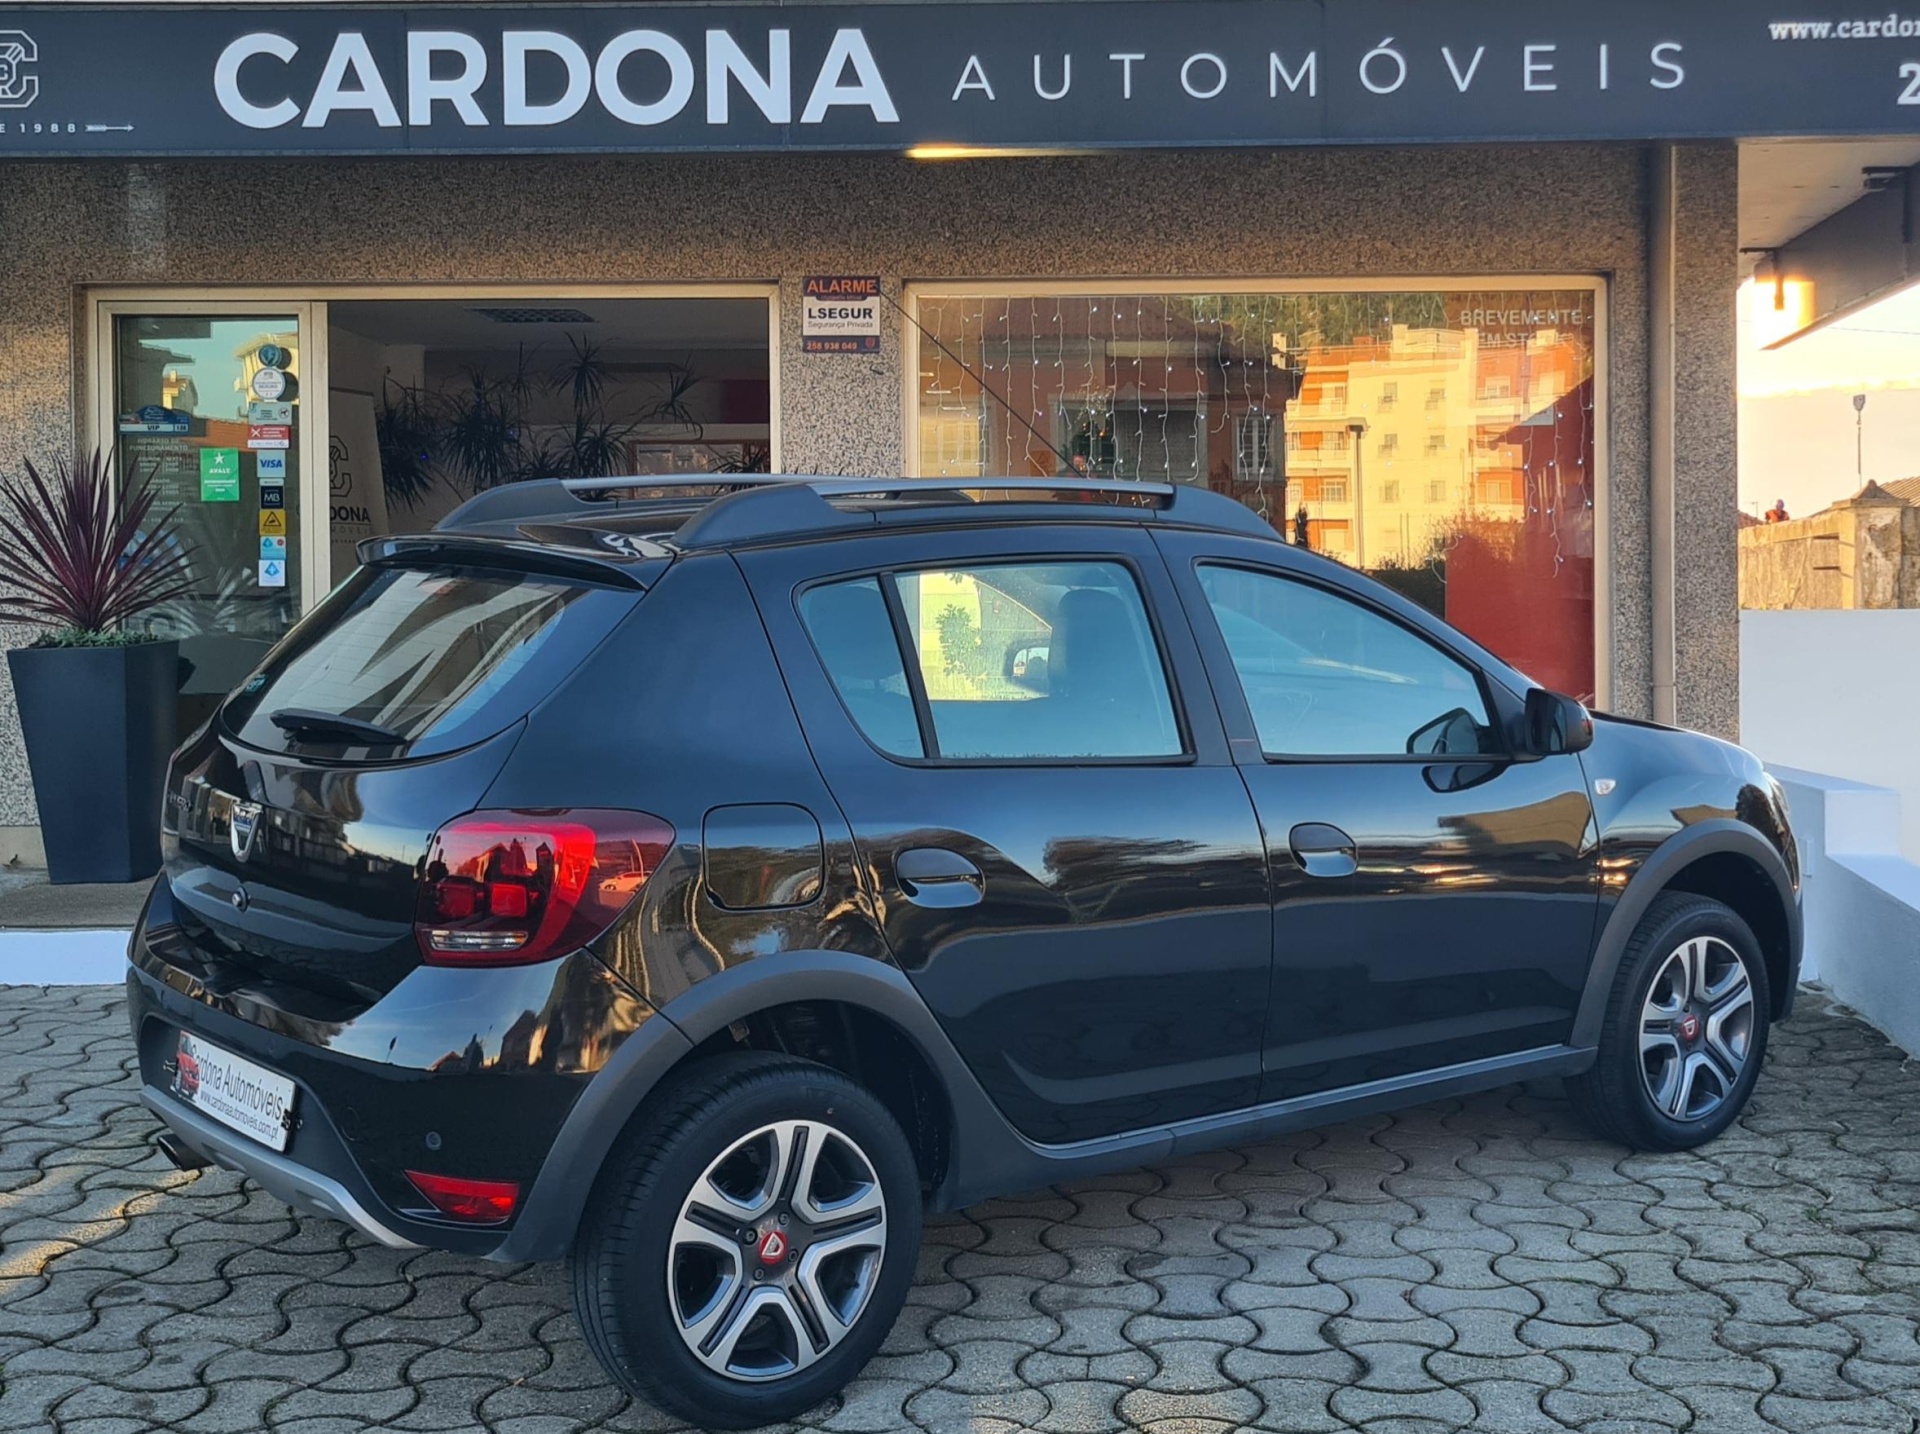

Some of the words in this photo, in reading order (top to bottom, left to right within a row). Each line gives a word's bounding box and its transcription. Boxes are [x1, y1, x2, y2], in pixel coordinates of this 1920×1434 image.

[213, 28, 900, 128] CARDONA
[952, 37, 1686, 102] AUTOMÓVEIS
[19, 123, 77, 133] 1988
[806, 279, 877, 294] ALARME
[808, 307, 873, 319] LSEGUR
[1460, 308, 1583, 326] BREVEMENTE
[807, 321, 846, 330] Segurança
[847, 321, 873, 329] Privada
[260, 460, 283, 468] VISA
[263, 493, 280, 502] MB
[330, 506, 371, 523] DONA
[222, 1064, 284, 1121] Automóveis
